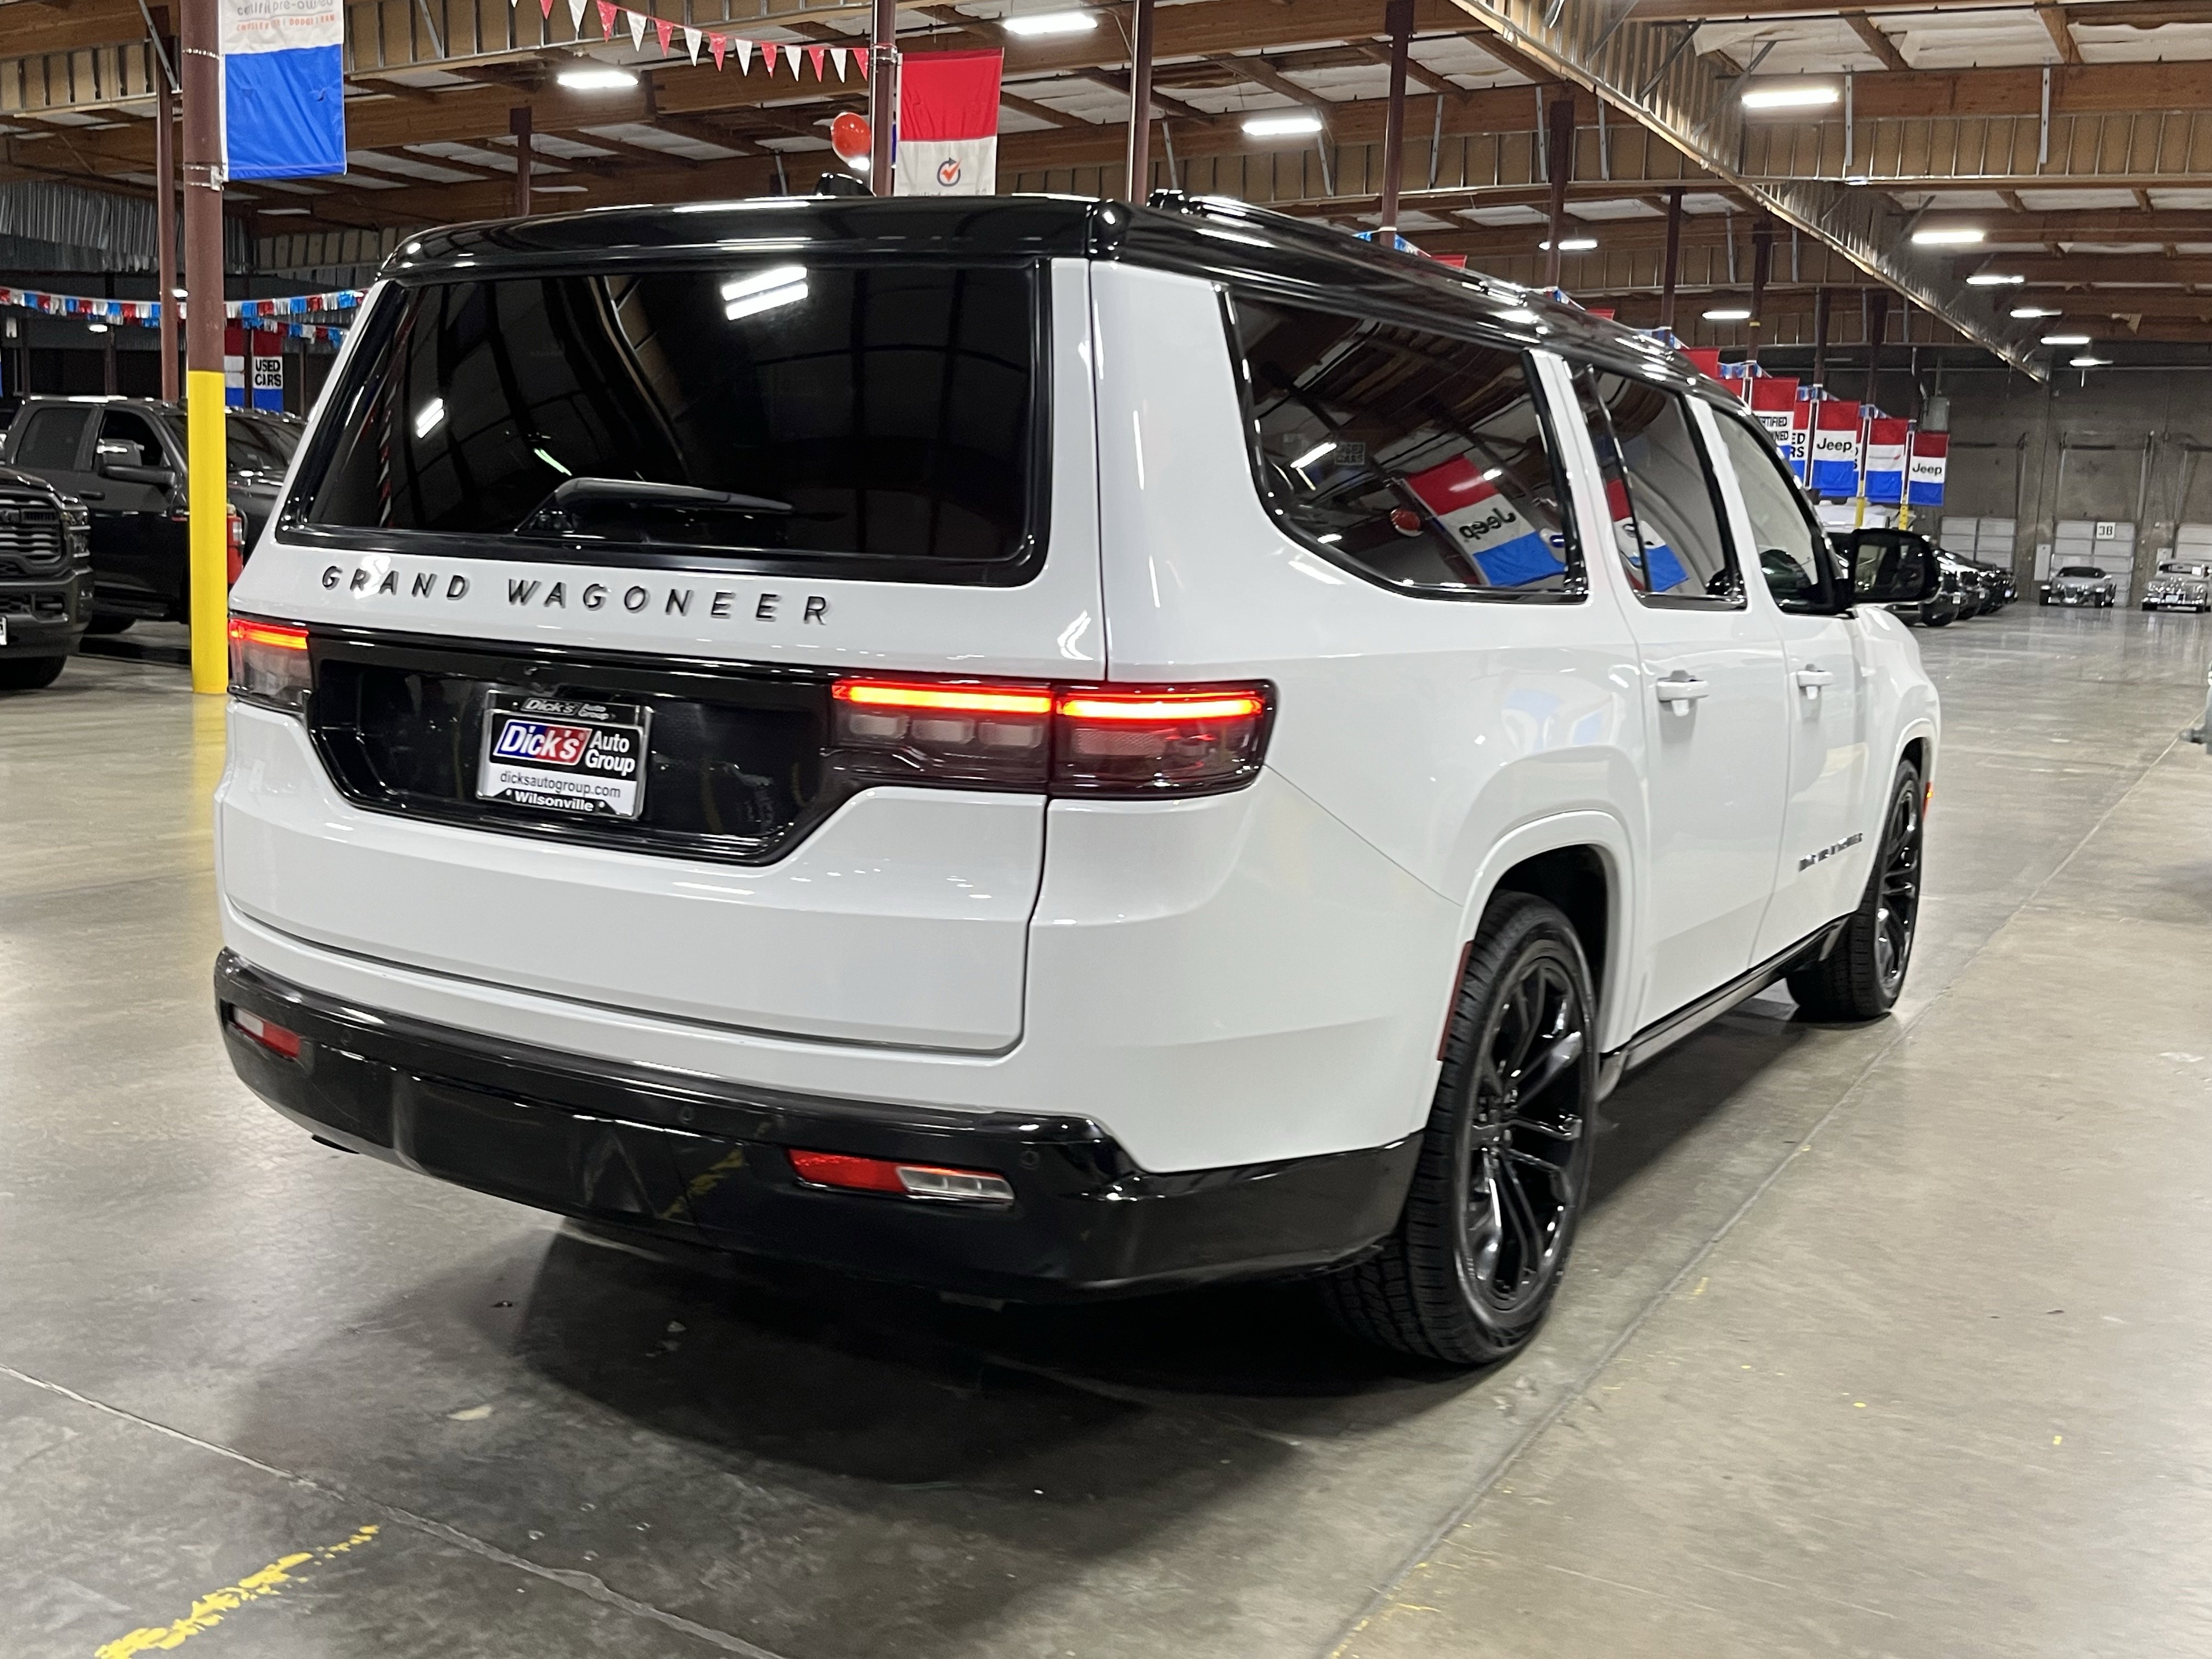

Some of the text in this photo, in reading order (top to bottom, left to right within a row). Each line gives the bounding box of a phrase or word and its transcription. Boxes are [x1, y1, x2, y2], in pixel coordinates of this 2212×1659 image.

[273, 0, 333, 13] pre-owed
[256, 359, 281, 372] USED
[1816, 438, 1852, 453] Jeep
[1912, 463, 1942, 476] Jeep
[322, 566, 832, 625] GRAND WAGONEER
[526, 699, 575, 713] Dick's
[500, 725, 580, 760] Dick's
[589, 731, 630, 753] Auto
[585, 749, 635, 776] Group
[500, 771, 621, 798] dicksautogroup.com
[515, 790, 594, 811] Wilsonville
